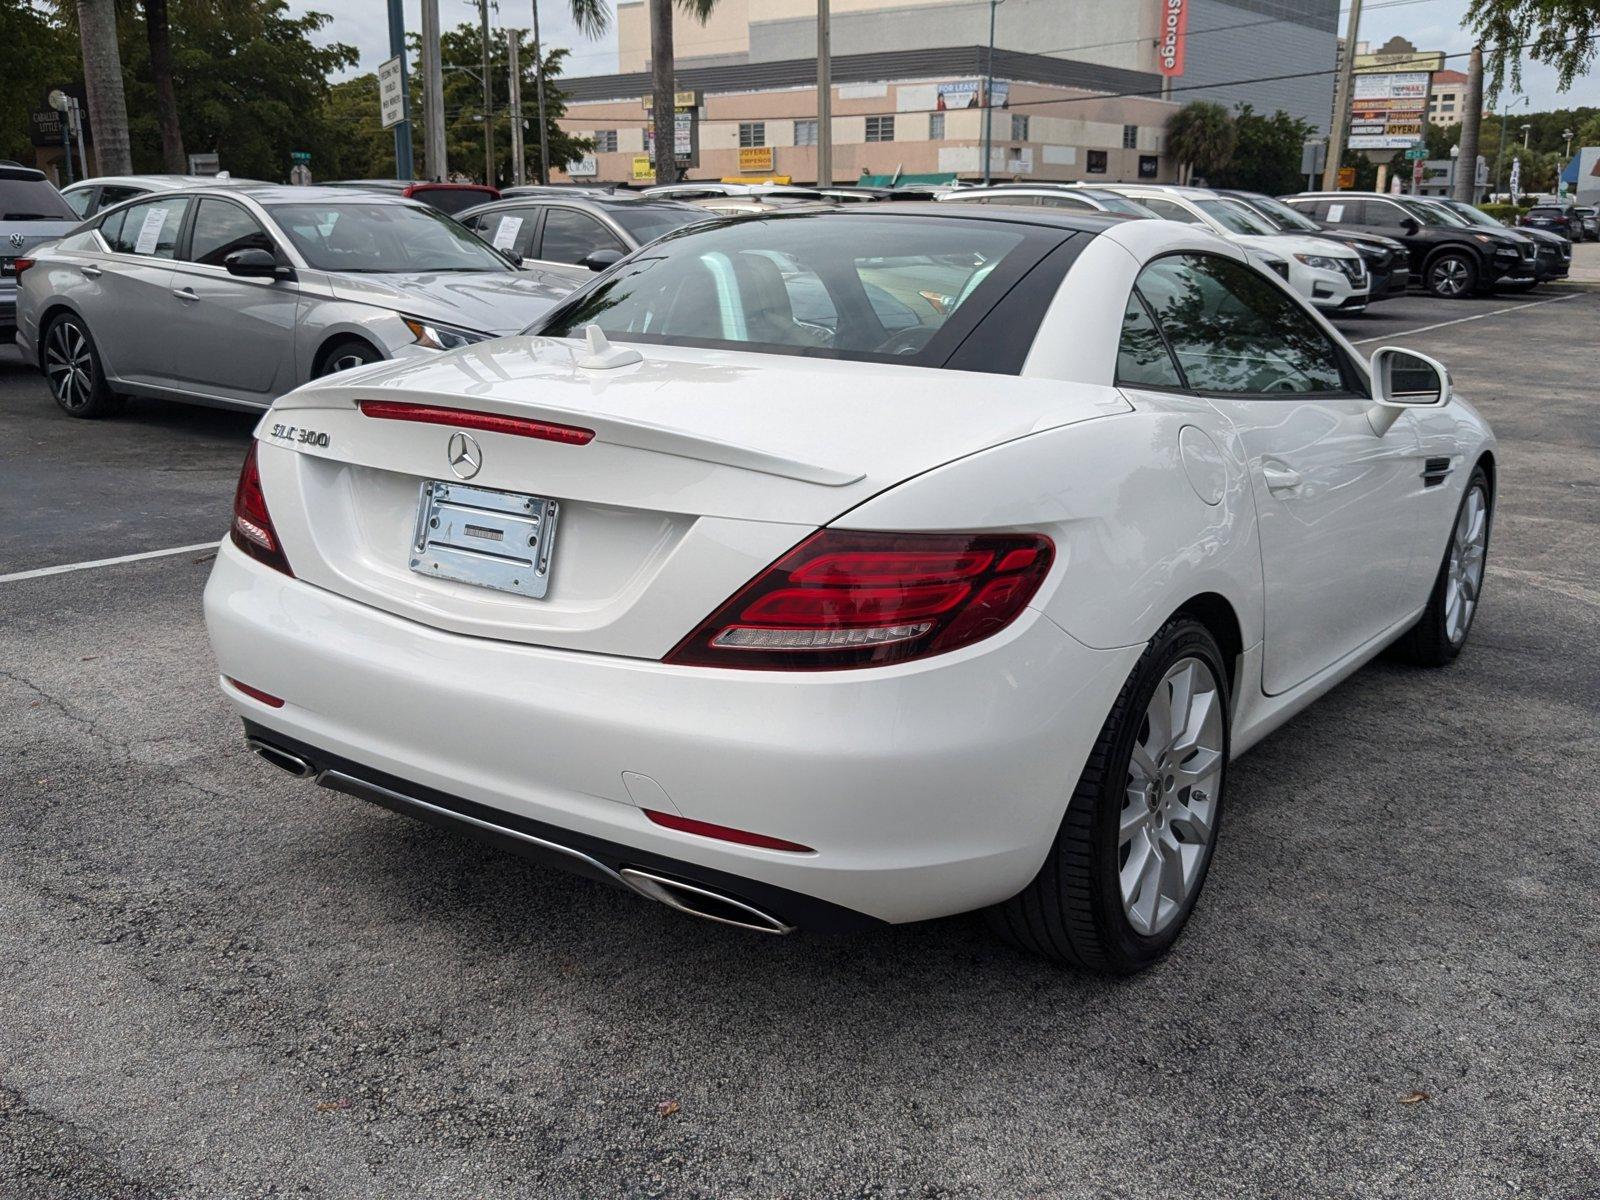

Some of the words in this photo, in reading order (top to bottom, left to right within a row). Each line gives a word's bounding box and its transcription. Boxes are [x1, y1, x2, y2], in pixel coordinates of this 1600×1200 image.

[1161, 0, 1181, 69] Storage
[938, 84, 954, 93] FOR
[955, 82, 978, 92] LEASE
[1386, 124, 1421, 134] JOYERIA
[739, 148, 771, 156] JOYERIA
[270, 423, 298, 441] SLC
[297, 428, 331, 448] 300
